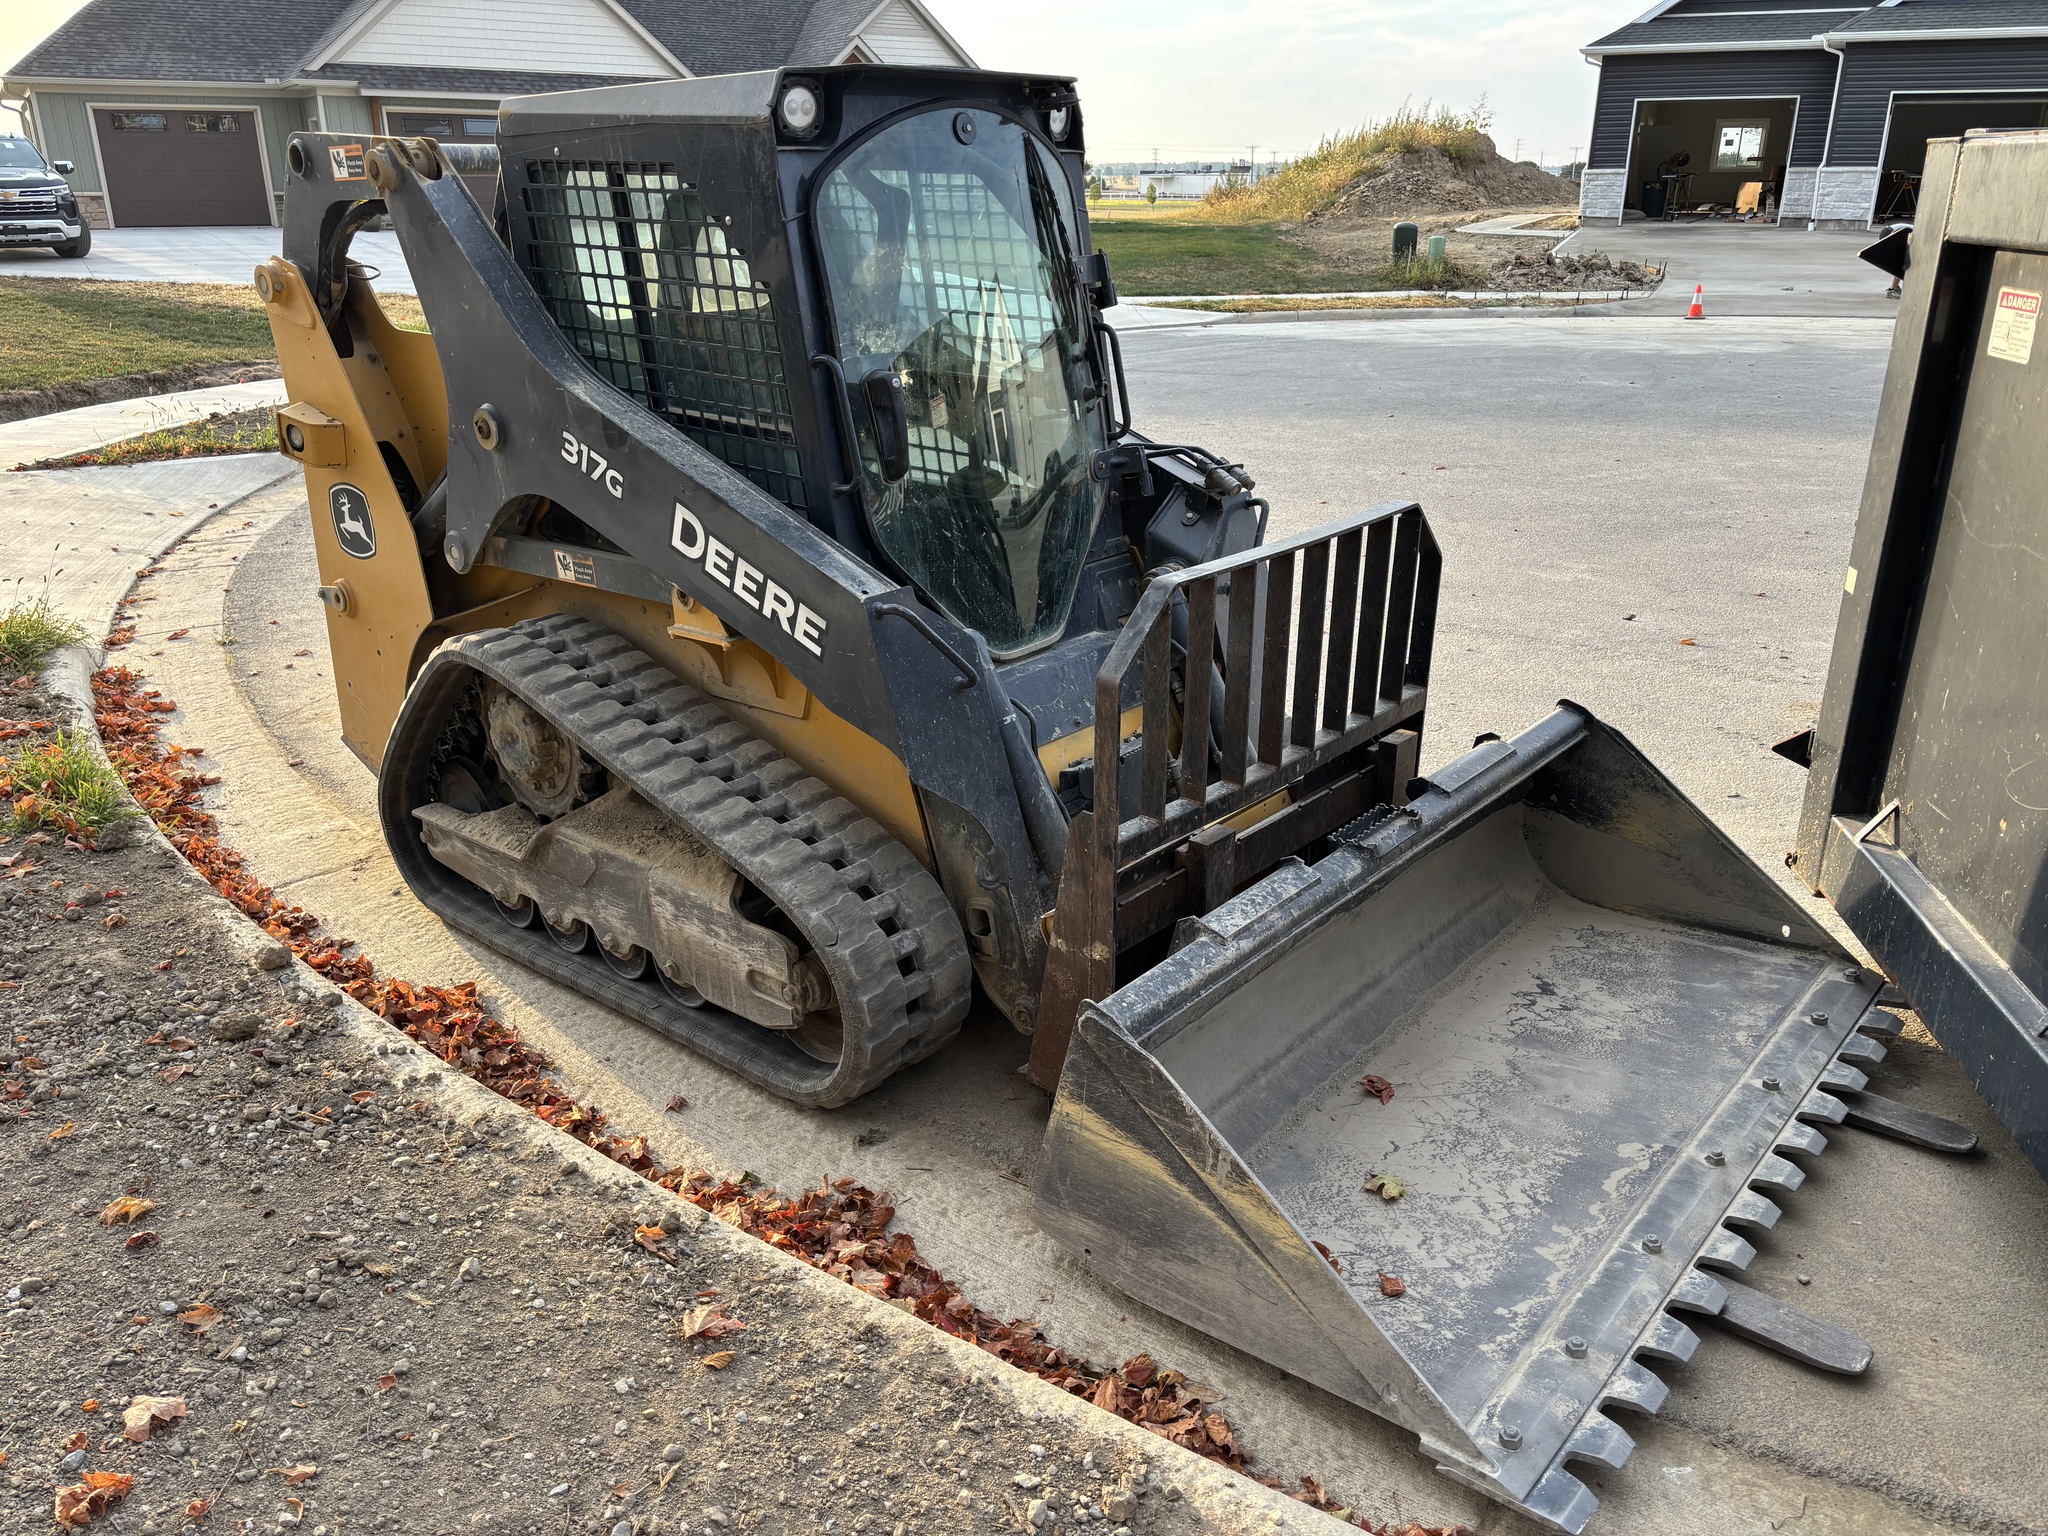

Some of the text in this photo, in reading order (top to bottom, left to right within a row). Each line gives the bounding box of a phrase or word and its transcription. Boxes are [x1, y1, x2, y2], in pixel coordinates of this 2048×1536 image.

[2008, 294, 2038, 311] DANGER
[561, 431, 624, 499] 317G
[671, 502, 827, 656] DEERE
